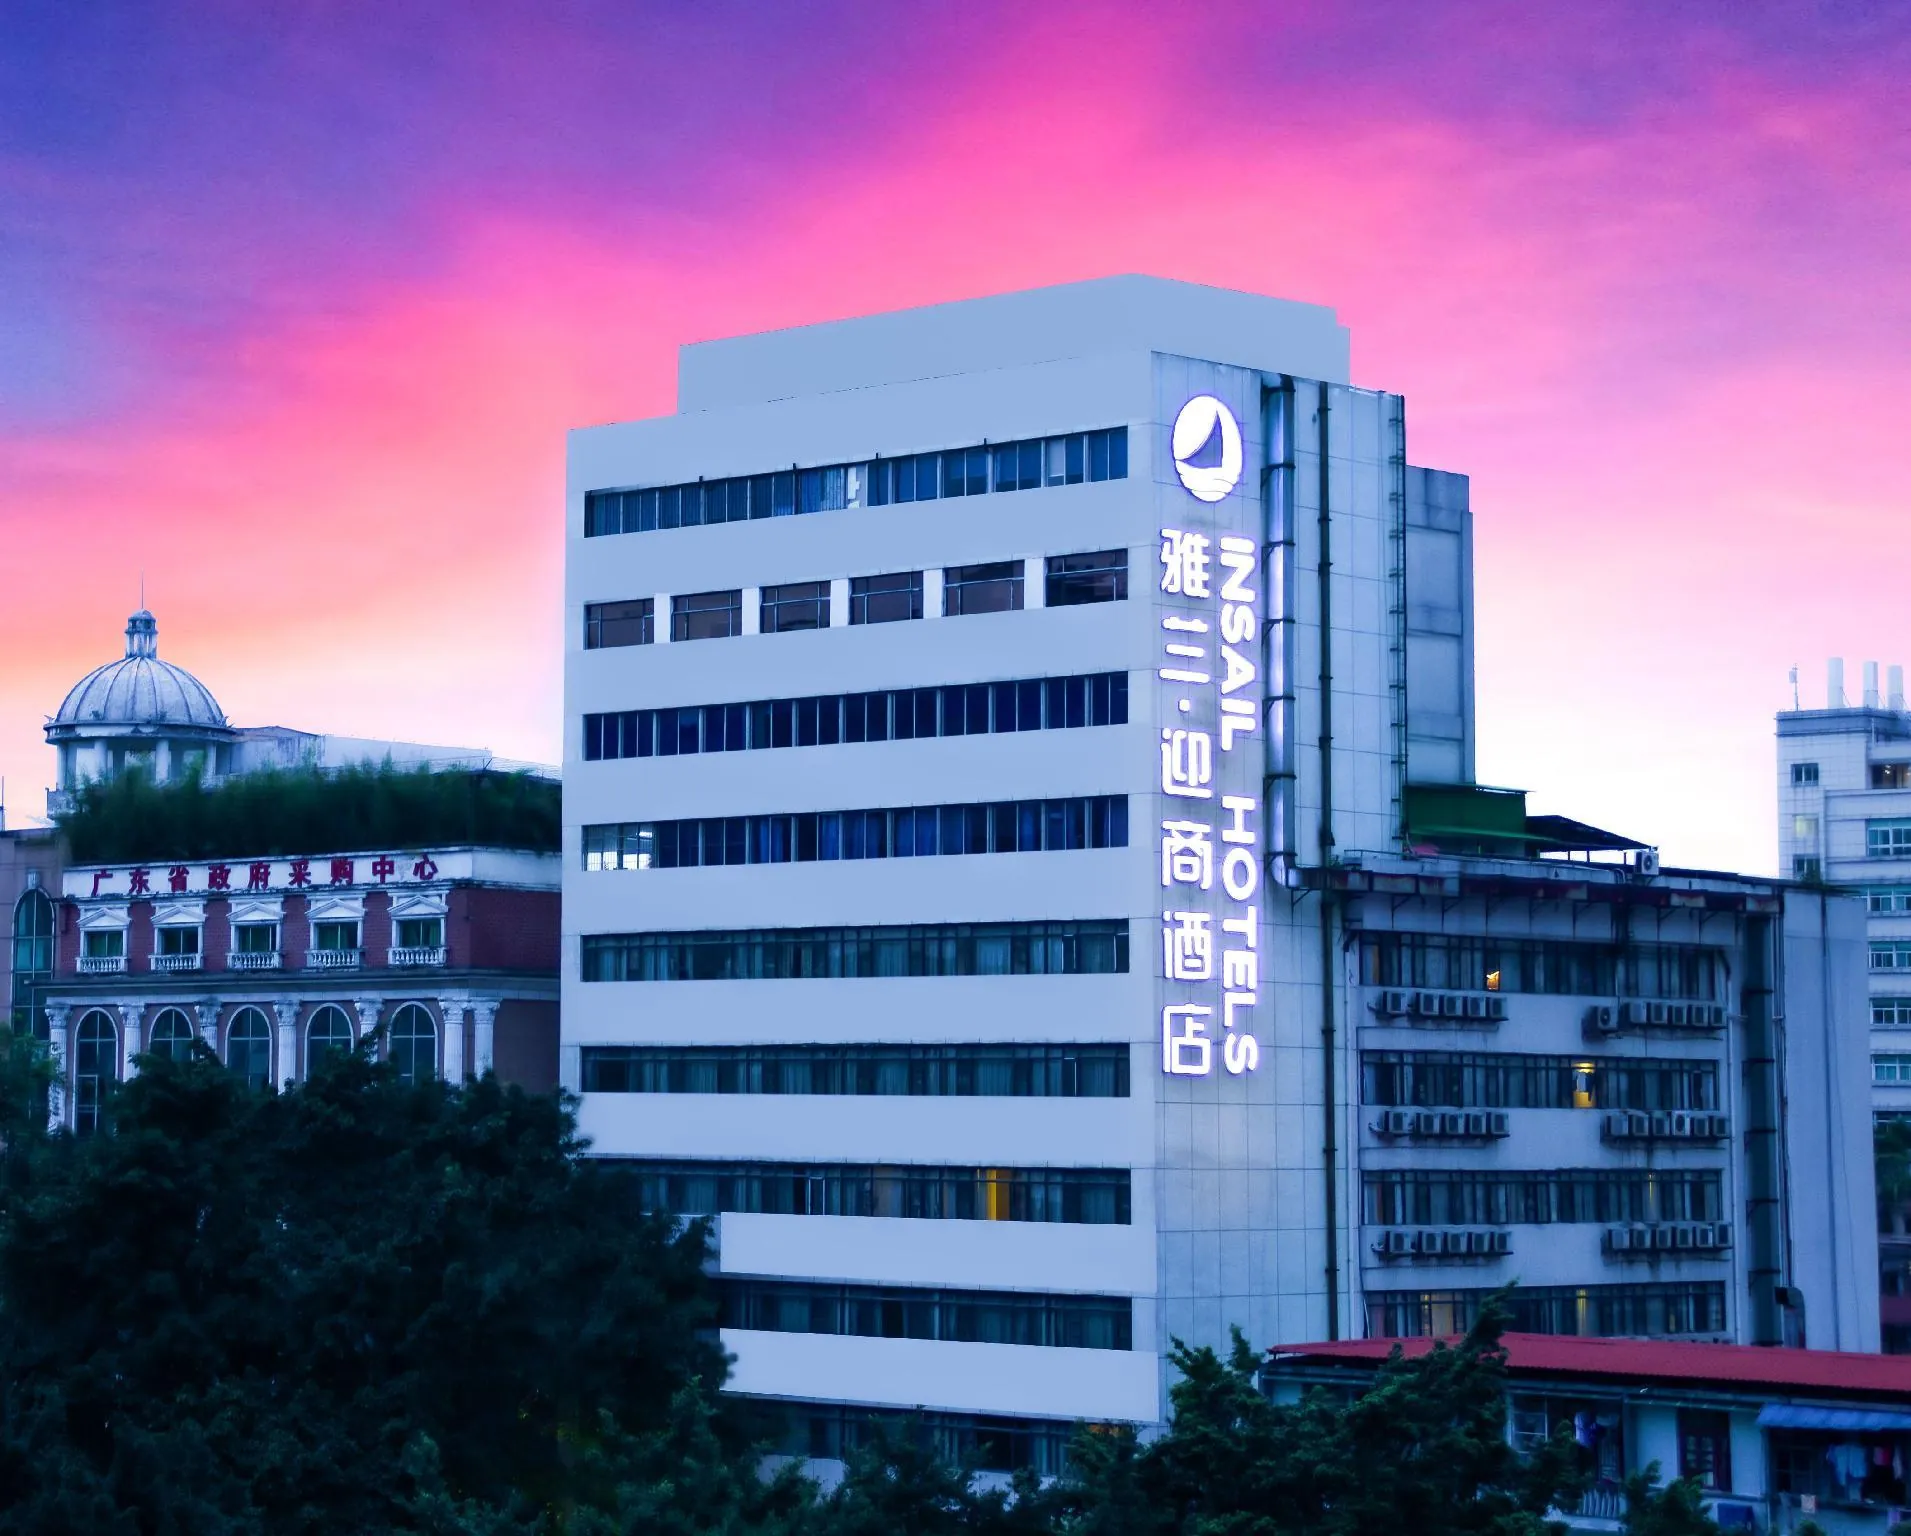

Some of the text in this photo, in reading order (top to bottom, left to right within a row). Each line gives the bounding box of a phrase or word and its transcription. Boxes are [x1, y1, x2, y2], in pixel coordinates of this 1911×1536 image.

[92, 854, 438, 896] 广东省政府采购中心
[1220, 537, 1258, 1074] INSAIL HOTELS
